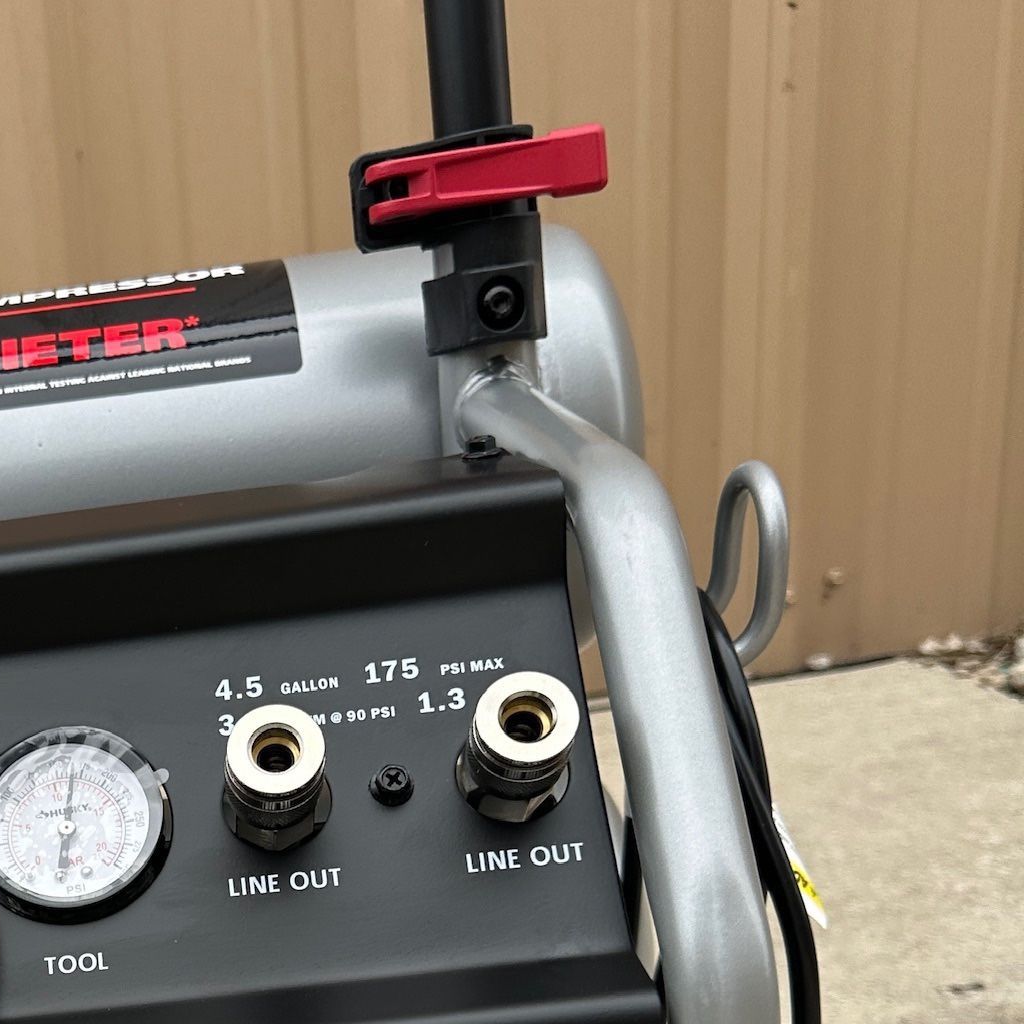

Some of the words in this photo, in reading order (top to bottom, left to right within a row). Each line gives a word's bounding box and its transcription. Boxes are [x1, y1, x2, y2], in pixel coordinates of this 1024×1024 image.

[49, 377, 86, 388] TESTING
[87, 372, 126, 383] AGAINST
[215, 676, 263, 701] 4.5
[280, 677, 339, 695] GALLON
[364, 657, 419, 684] 175
[440, 662, 465, 676] PSI
[470, 657, 504, 672] MAX
[346, 709, 366, 722] 90
[371, 705, 396, 719] PSI
[418, 687, 466, 714] 1.3
[67, 855, 84, 866] AR
[465, 848, 521, 873] LINE
[530, 842, 584, 866] OUT
[66, 884, 86, 894] PSI
[228, 874, 280, 897] LINE
[289, 868, 341, 890] OUT
[44, 952, 109, 975] TOOL
